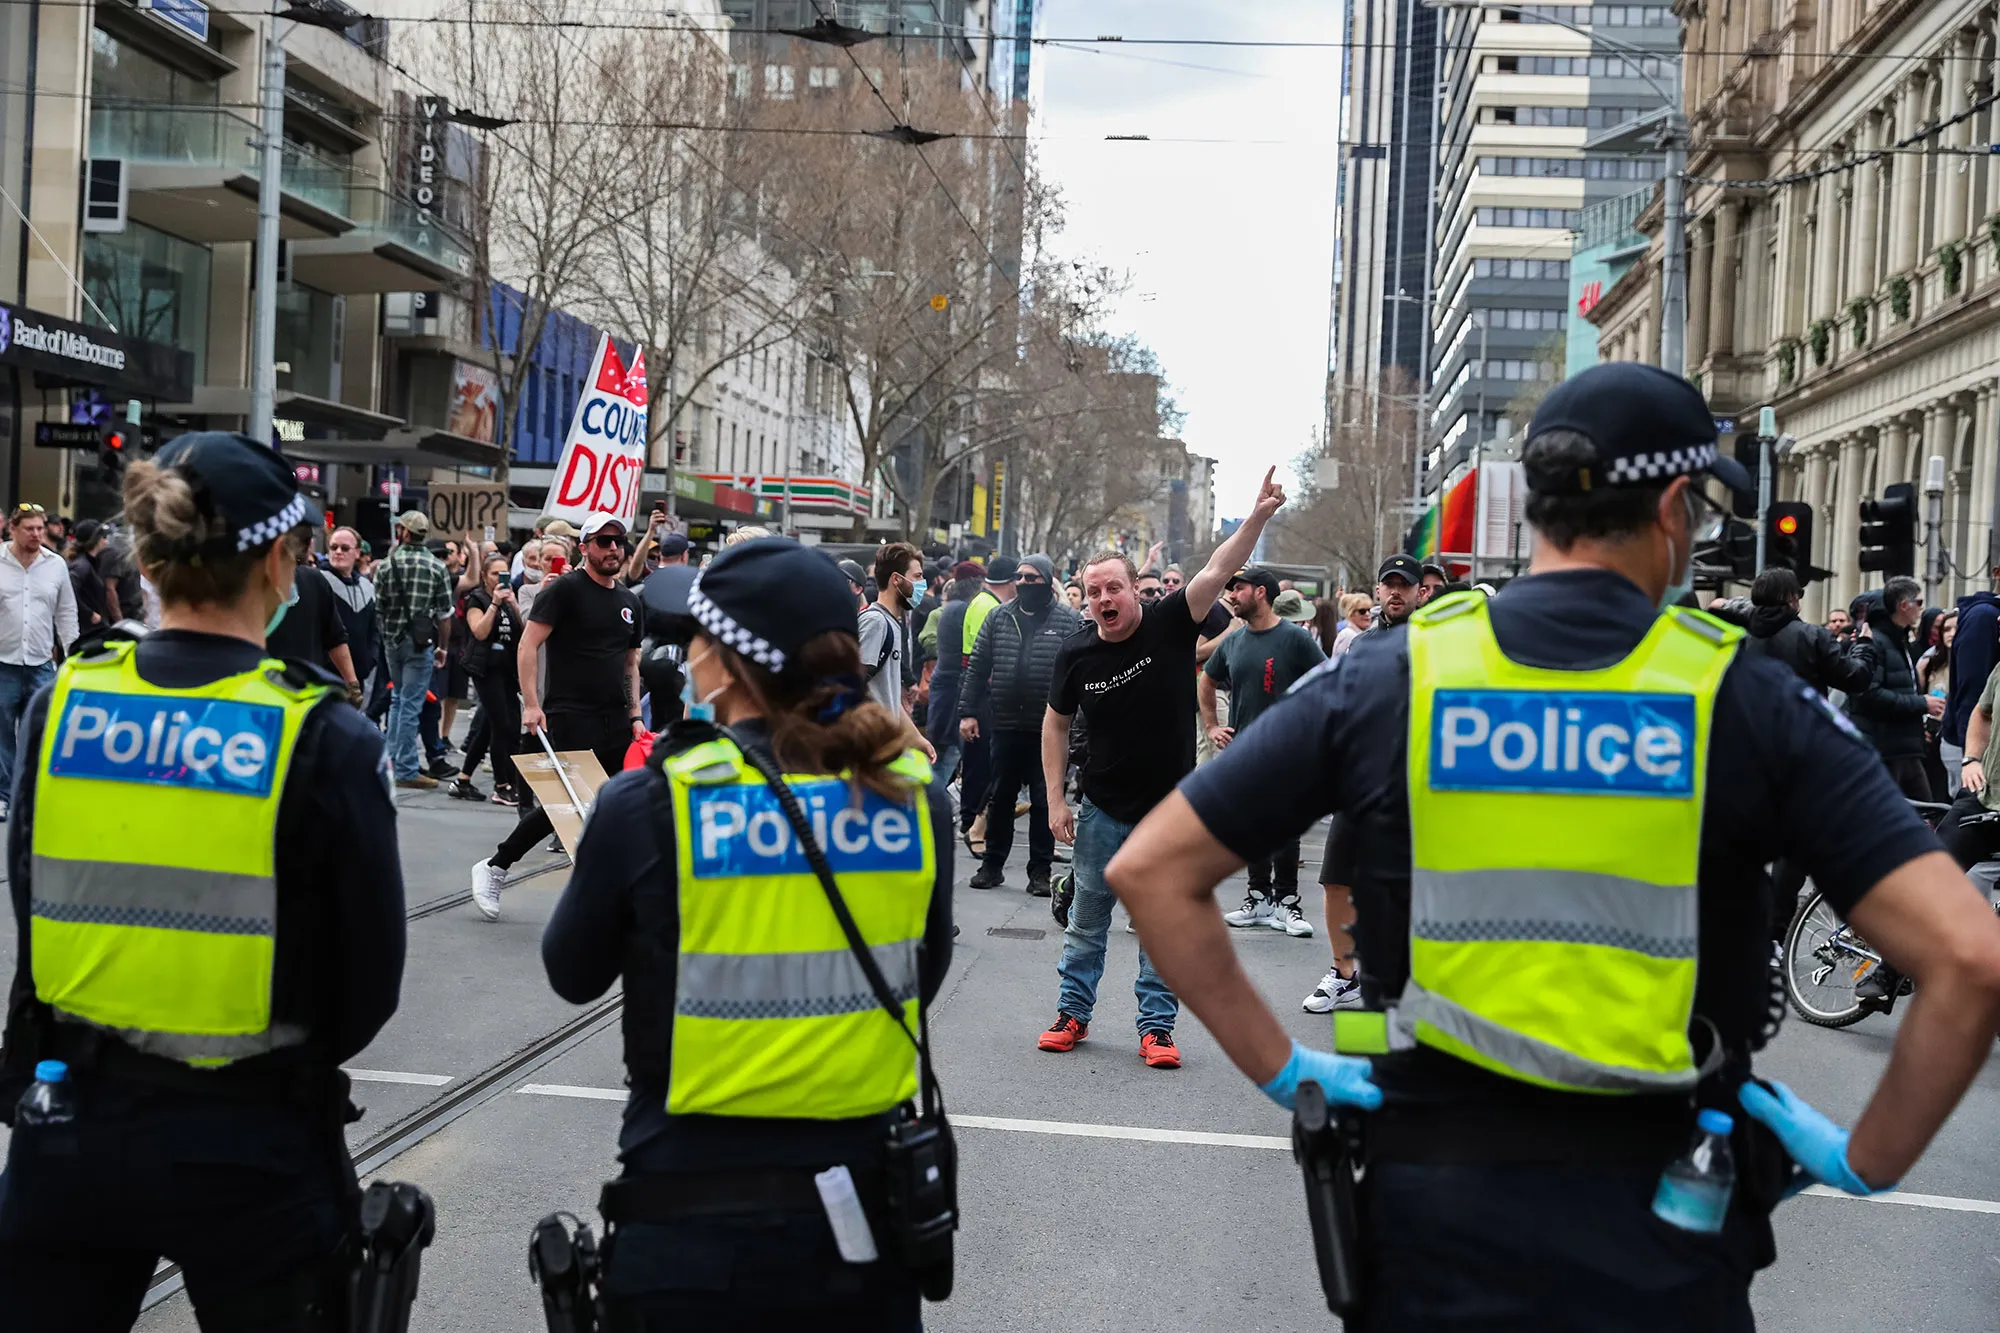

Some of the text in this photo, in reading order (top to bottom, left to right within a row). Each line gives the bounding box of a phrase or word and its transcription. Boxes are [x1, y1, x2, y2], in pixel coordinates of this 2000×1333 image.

[13, 318, 125, 370] Bank of Melbourne
[61, 705, 266, 777] Police
[1441, 706, 1682, 775] Police
